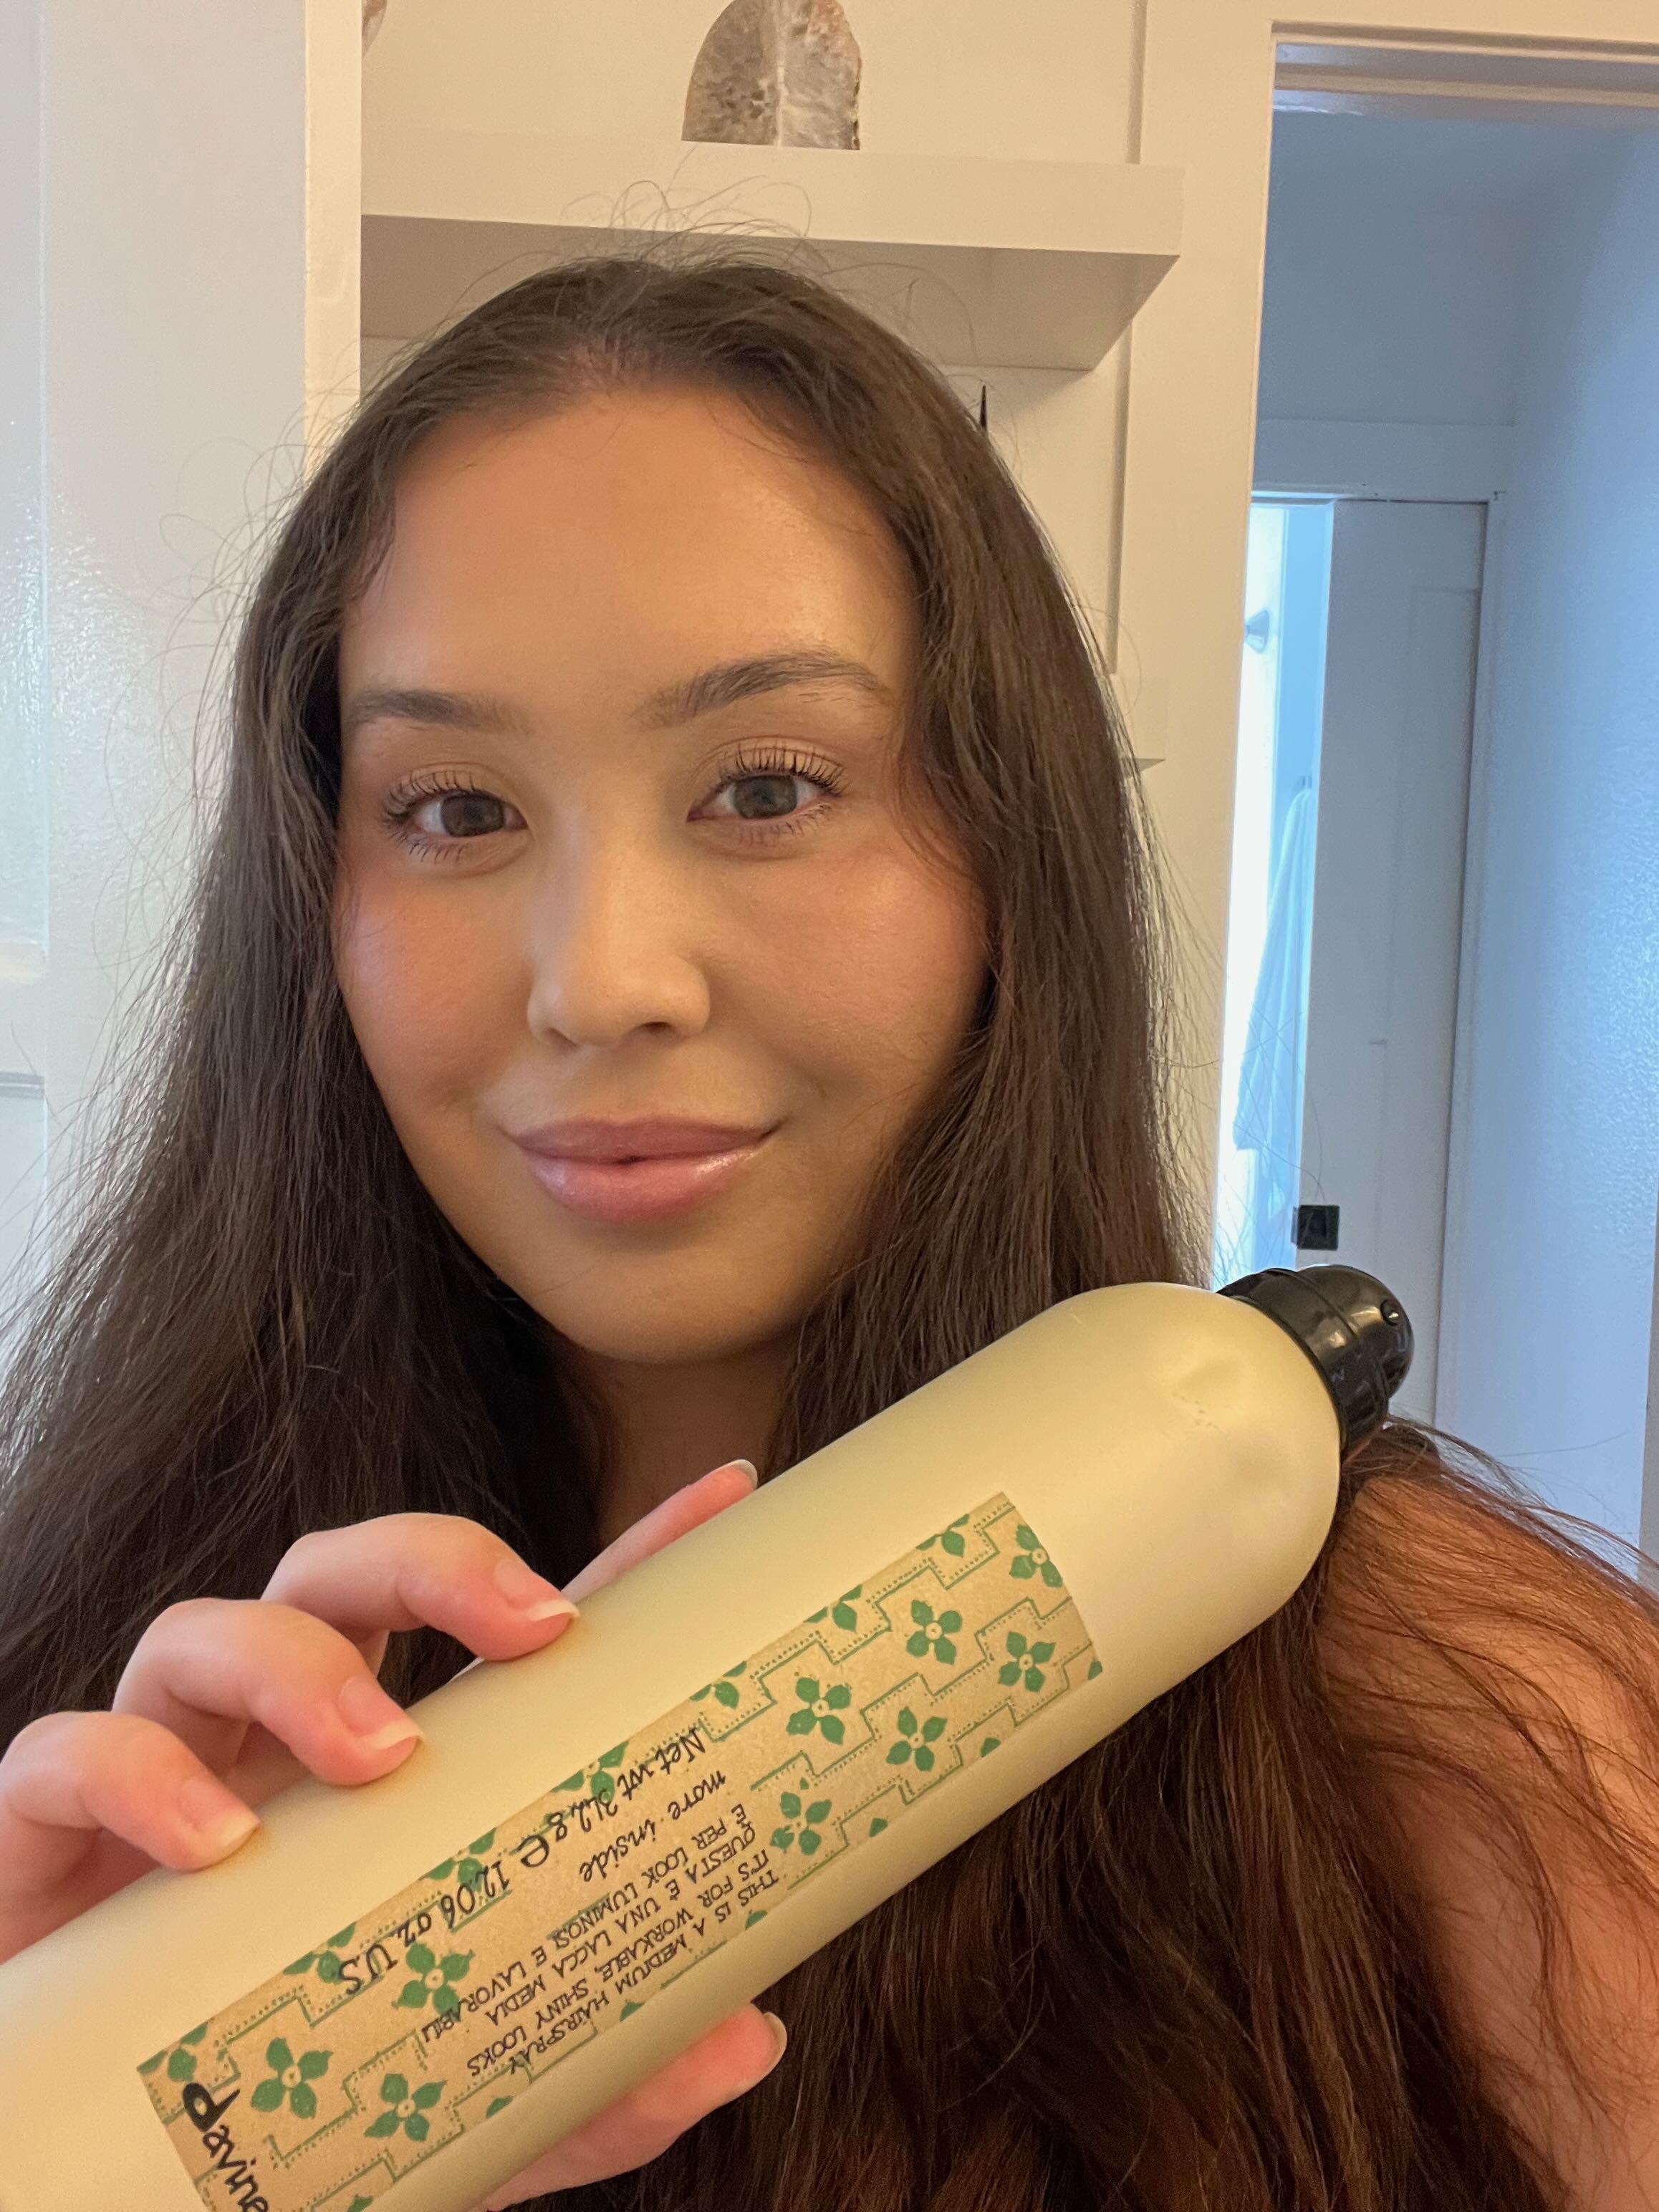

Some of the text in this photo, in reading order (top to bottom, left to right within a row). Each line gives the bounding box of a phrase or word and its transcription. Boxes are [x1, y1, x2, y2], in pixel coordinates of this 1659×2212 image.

[653, 1726, 705, 1774] Net
[617, 1761, 654, 1800] wt
[545, 1811, 567, 1842] g
[570, 1792, 617, 1832] 342
[579, 1770, 726, 1882] more inside
[691, 1818, 726, 1850] PER
[641, 1847, 688, 1888] LOOK
[683, 1821, 755, 1883] QUESTA
[551, 1882, 638, 1949] LUMINOSI
[615, 1898, 660, 1933] UNA
[466, 1849, 769, 2076] IT'S FOR WORKABLE, SHINY LOOKS
[509, 1870, 779, 2074] THIS IS A MEDIUM HAIRSPRAY
[531, 1946, 547, 1966] E
[551, 1930, 611, 1978] LACCA
[421, 1961, 526, 2042] LAVORABILI
[484, 1974, 546, 2026] MEDIA
